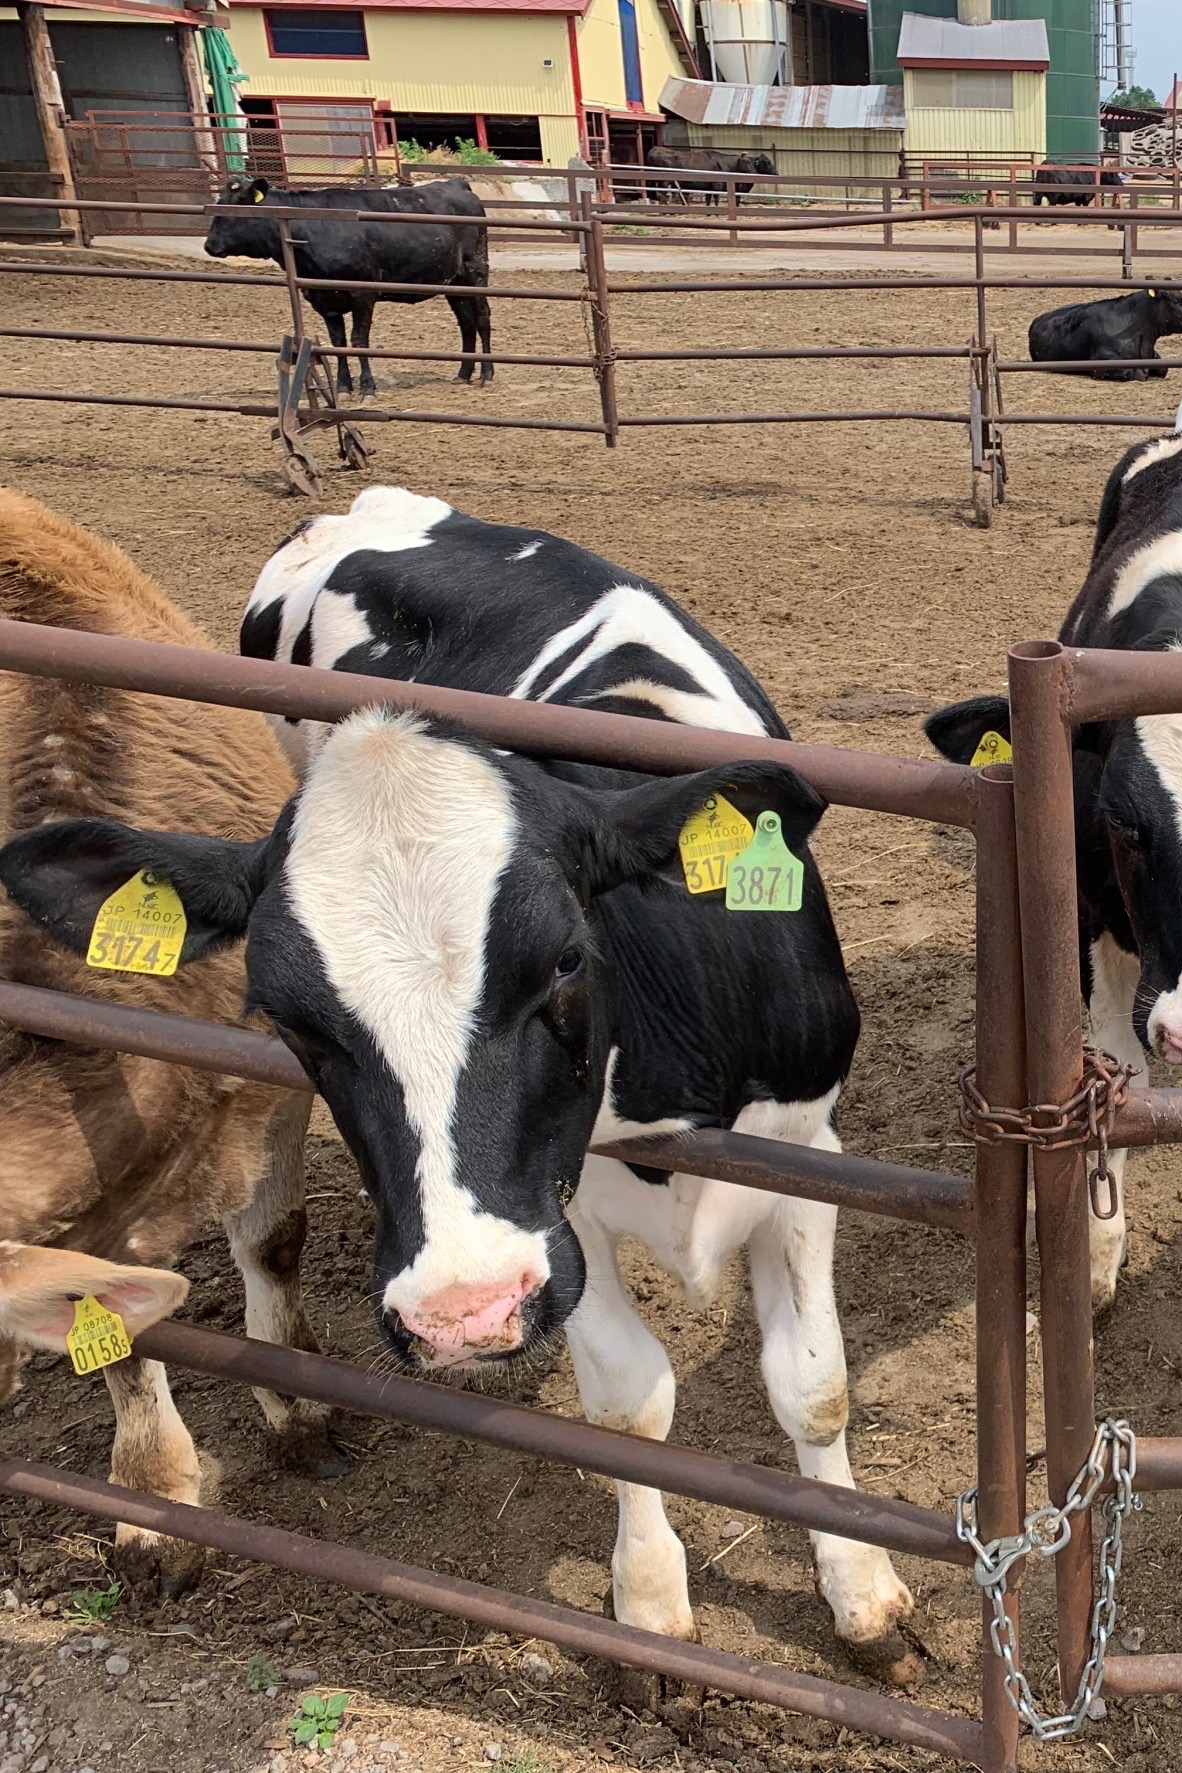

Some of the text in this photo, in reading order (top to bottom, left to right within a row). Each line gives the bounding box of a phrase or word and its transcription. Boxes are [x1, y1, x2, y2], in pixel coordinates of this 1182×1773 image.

[681, 833, 698, 846] JP
[705, 823, 747, 840] 14007
[731, 865, 795, 906] 3871
[103, 905, 182, 924] JP 14007
[71, 1313, 113, 1337] JP 08708
